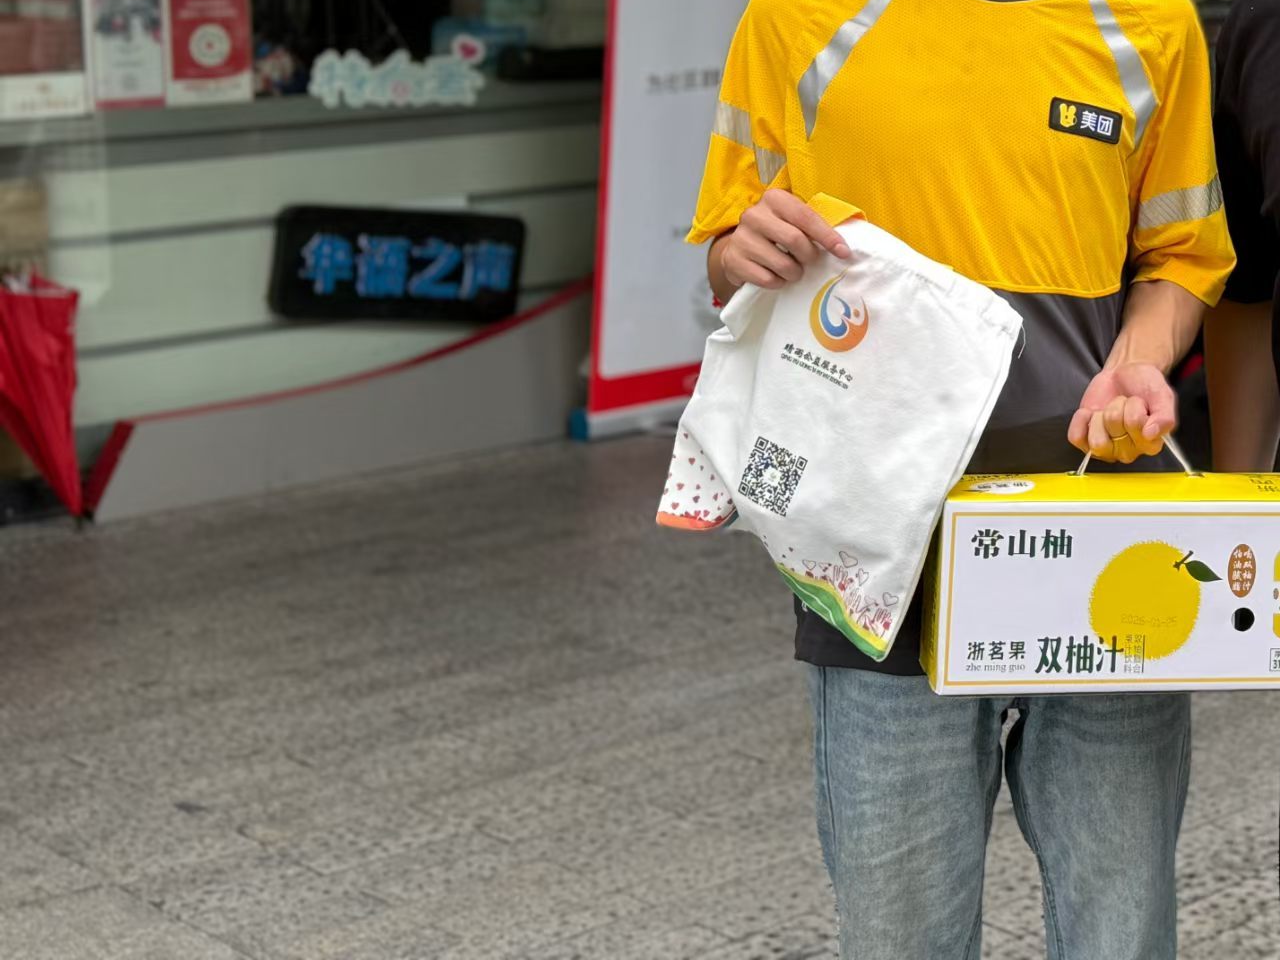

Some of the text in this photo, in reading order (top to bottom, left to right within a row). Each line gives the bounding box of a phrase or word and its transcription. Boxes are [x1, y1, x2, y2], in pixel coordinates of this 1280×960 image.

[1080, 110, 1114, 136] 美团
[971, 528, 1073, 559] 常山柚
[967, 641, 1026, 661] 浙茗果
[1034, 635, 1125, 674] 双柚汁
[965, 662, 982, 672] zhe
[1008, 663, 1026, 674] guo
